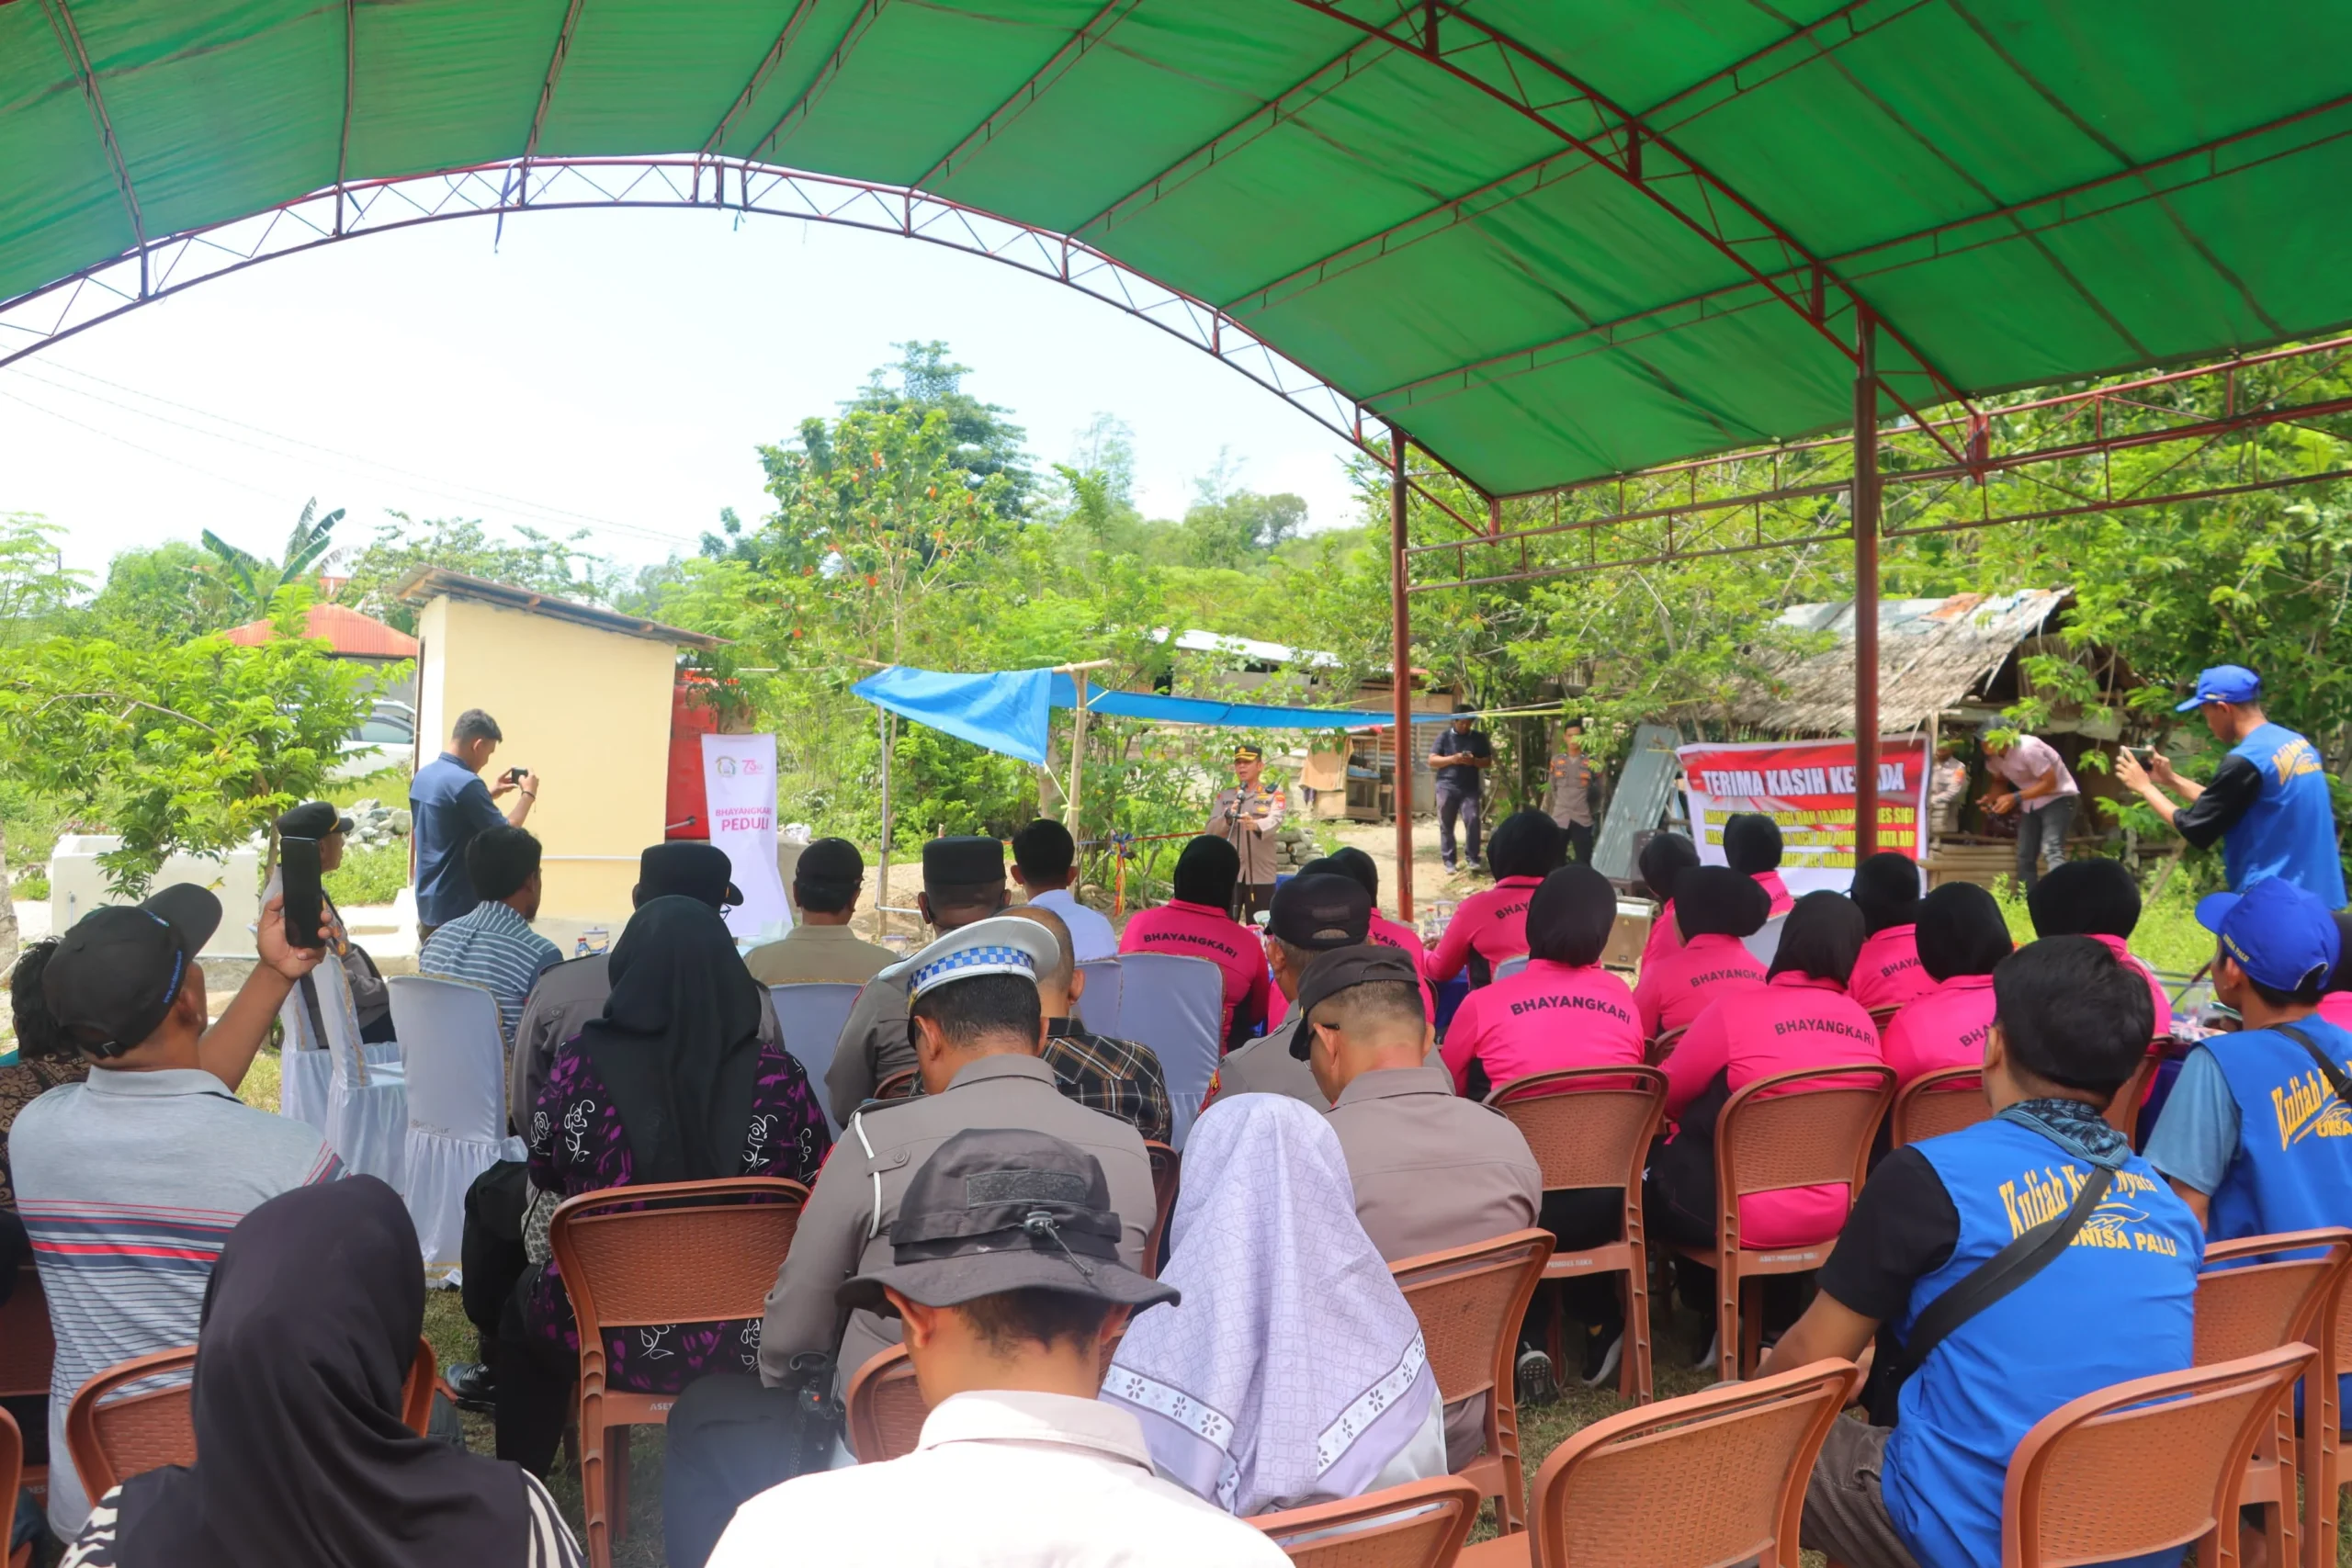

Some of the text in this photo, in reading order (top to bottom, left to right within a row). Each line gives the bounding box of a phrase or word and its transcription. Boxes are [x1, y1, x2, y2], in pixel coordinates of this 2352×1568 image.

[1702, 762, 1905, 796] TERIMA KASIH KEDA
[721, 817, 769, 831] PEDULI
[1894, 807, 1915, 824] SIGI
[1143, 932, 1238, 959] BHAYANGKARI
[1690, 968, 1768, 988] BHAYANGKA
[1510, 995, 1631, 1025] BHAYANGKARI
[1773, 1018, 1875, 1048] BHAYANGKARI
[2270, 1069, 2323, 1153] Kuliah
[1998, 1166, 2068, 1240] Kuliah
[2115, 1168, 2159, 1200] Nyata
[2133, 1231, 2177, 1258] PALU
